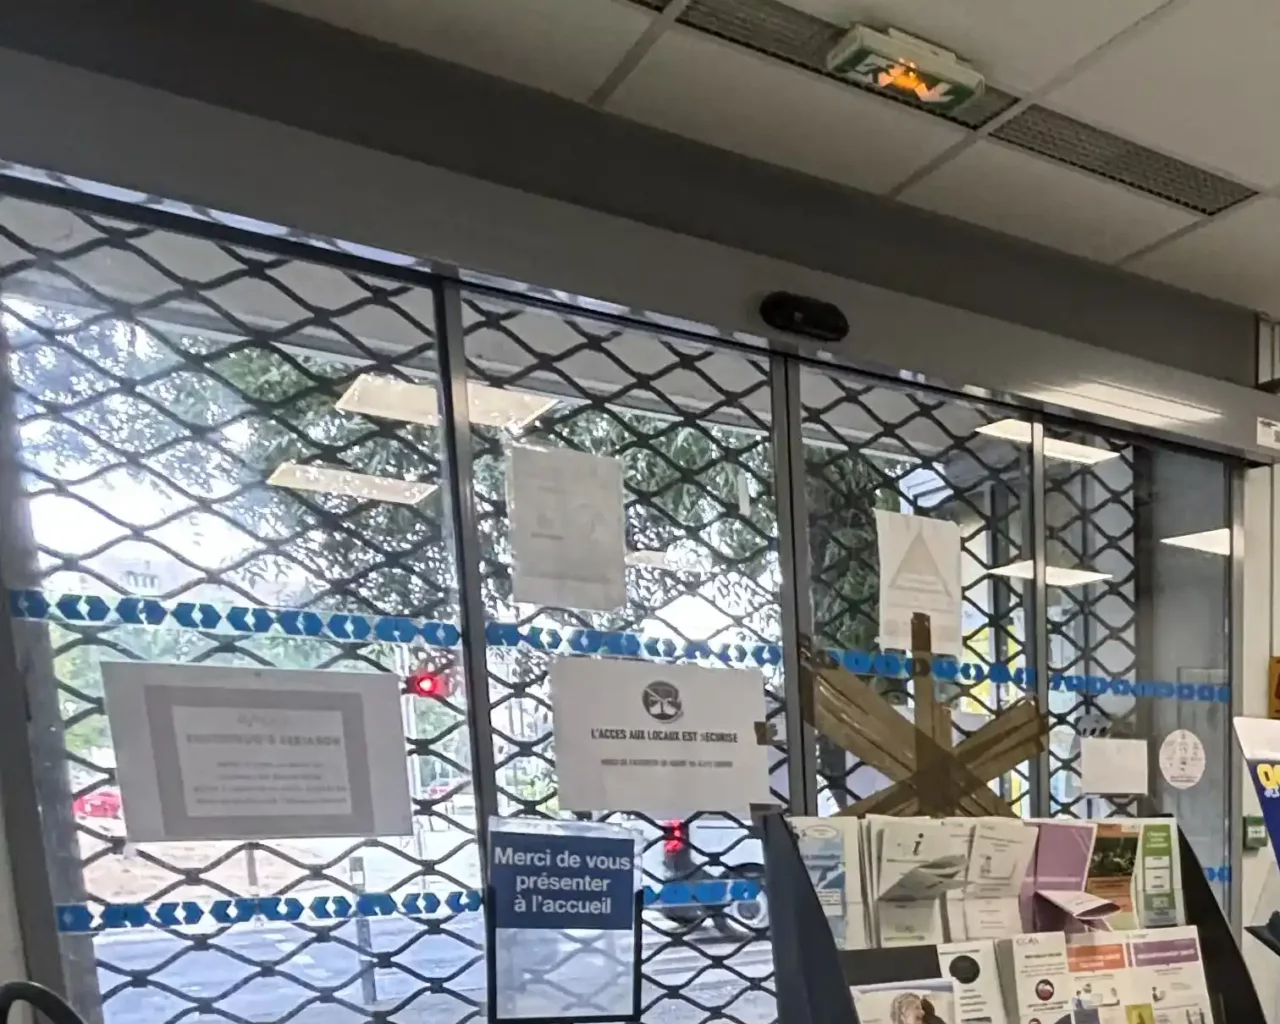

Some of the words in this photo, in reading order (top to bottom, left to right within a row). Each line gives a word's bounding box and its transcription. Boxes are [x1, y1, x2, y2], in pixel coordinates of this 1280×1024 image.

[629, 729, 645, 740] AUX
[648, 730, 679, 741] LOCAUX
[682, 731, 697, 742] EST
[494, 847, 550, 866] Merci
[556, 851, 581, 868] de
[586, 856, 631, 870] vous
[516, 872, 611, 892] présenter
[514, 895, 526, 912] à
[532, 895, 611, 914] l'accueil
